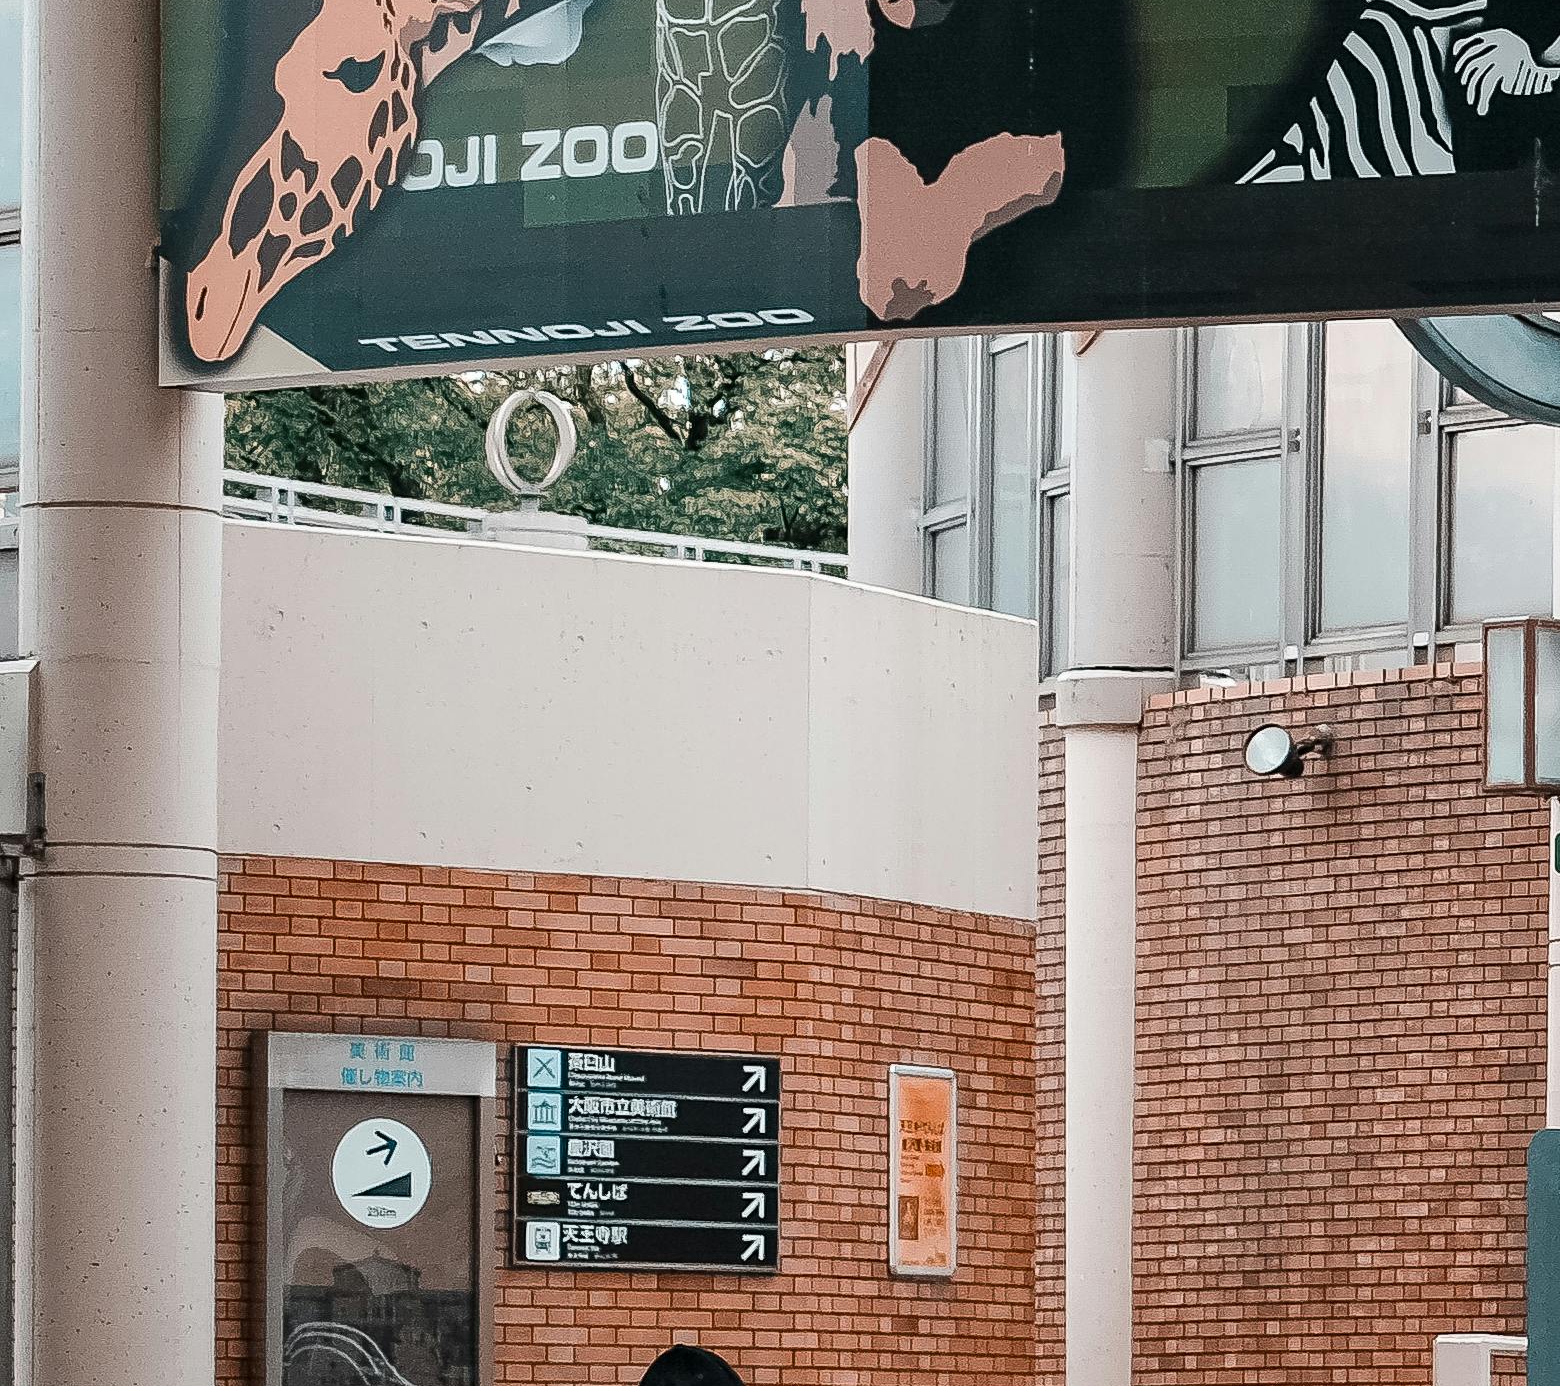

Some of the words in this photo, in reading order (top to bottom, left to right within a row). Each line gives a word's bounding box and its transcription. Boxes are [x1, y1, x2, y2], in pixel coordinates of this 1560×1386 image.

[521, 120, 657, 182] ZOO
[359, 319, 651, 352] TENNOJI
[663, 308, 815, 332] ZOO
[567, 1182, 629, 1201] てんしば
